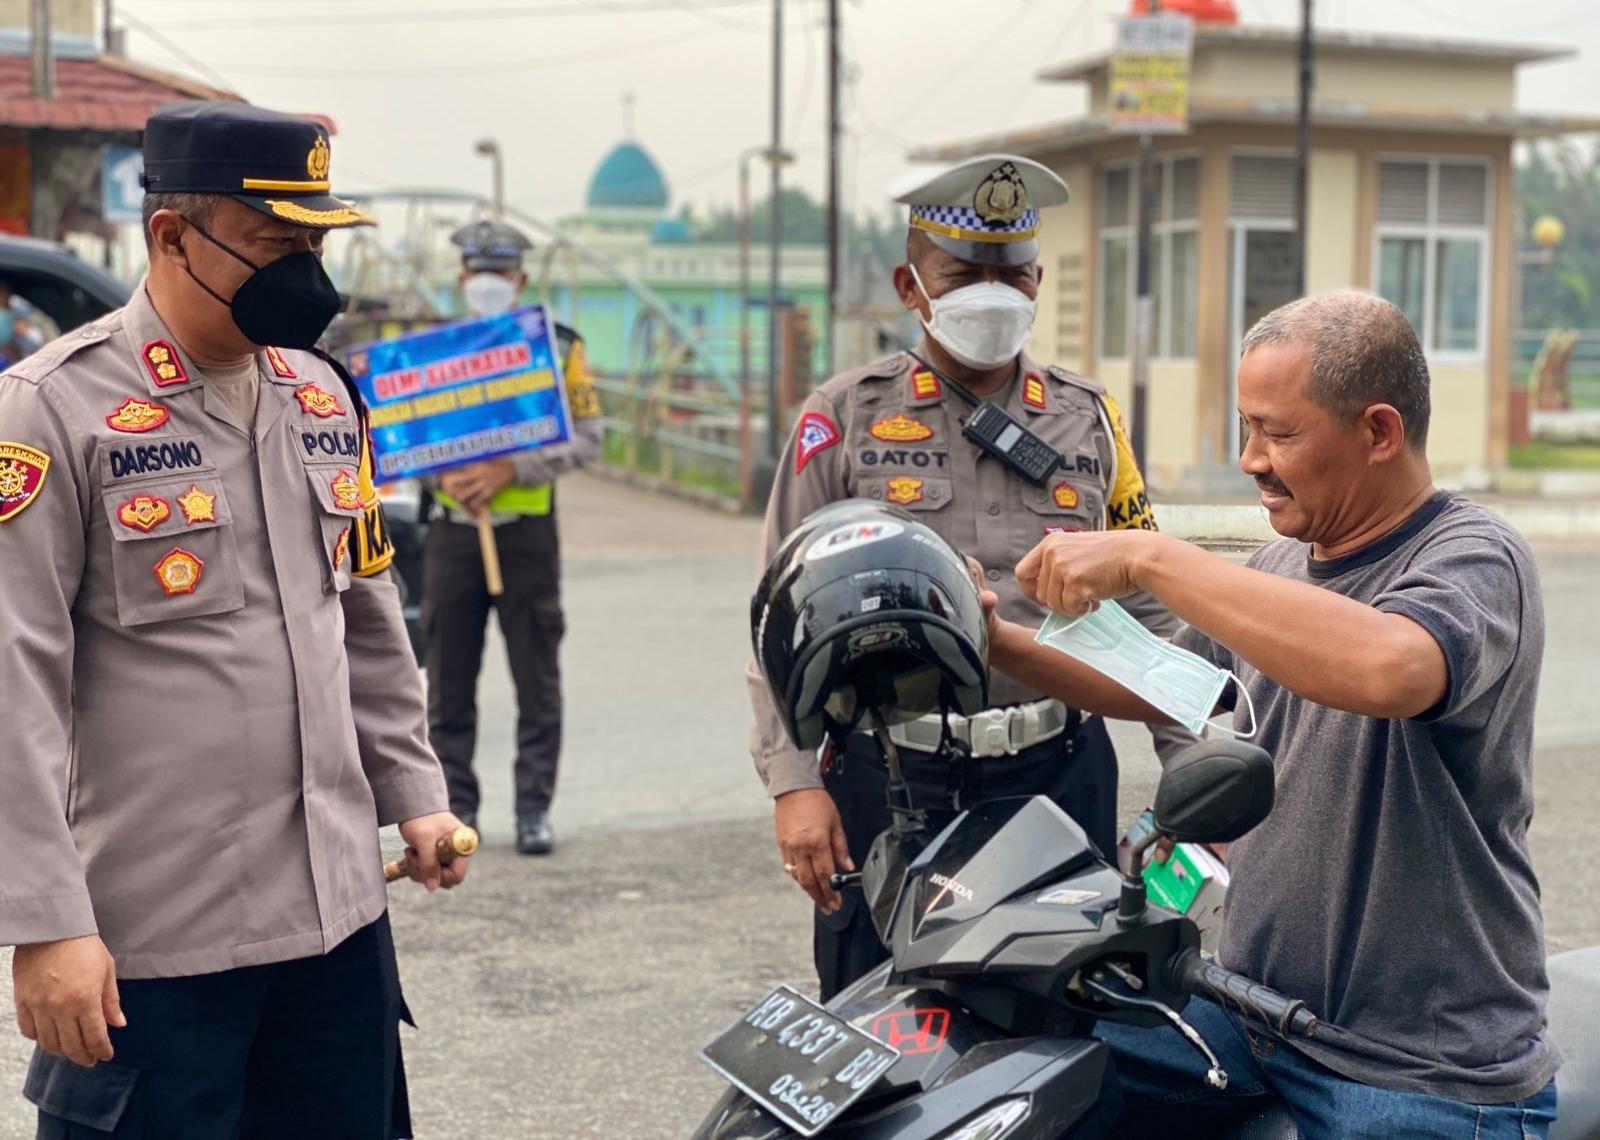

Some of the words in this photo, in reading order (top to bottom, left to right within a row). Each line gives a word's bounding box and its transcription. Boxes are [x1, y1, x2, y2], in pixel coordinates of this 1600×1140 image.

[426, 344, 530, 387] KESEHATAN
[109, 440, 202, 478] DARSONO
[301, 430, 358, 457] POLRI
[861, 450, 948, 468] GATOT
[929, 872, 974, 902] HONDA
[745, 992, 795, 1032] KB
[777, 1012, 850, 1065] 4337
